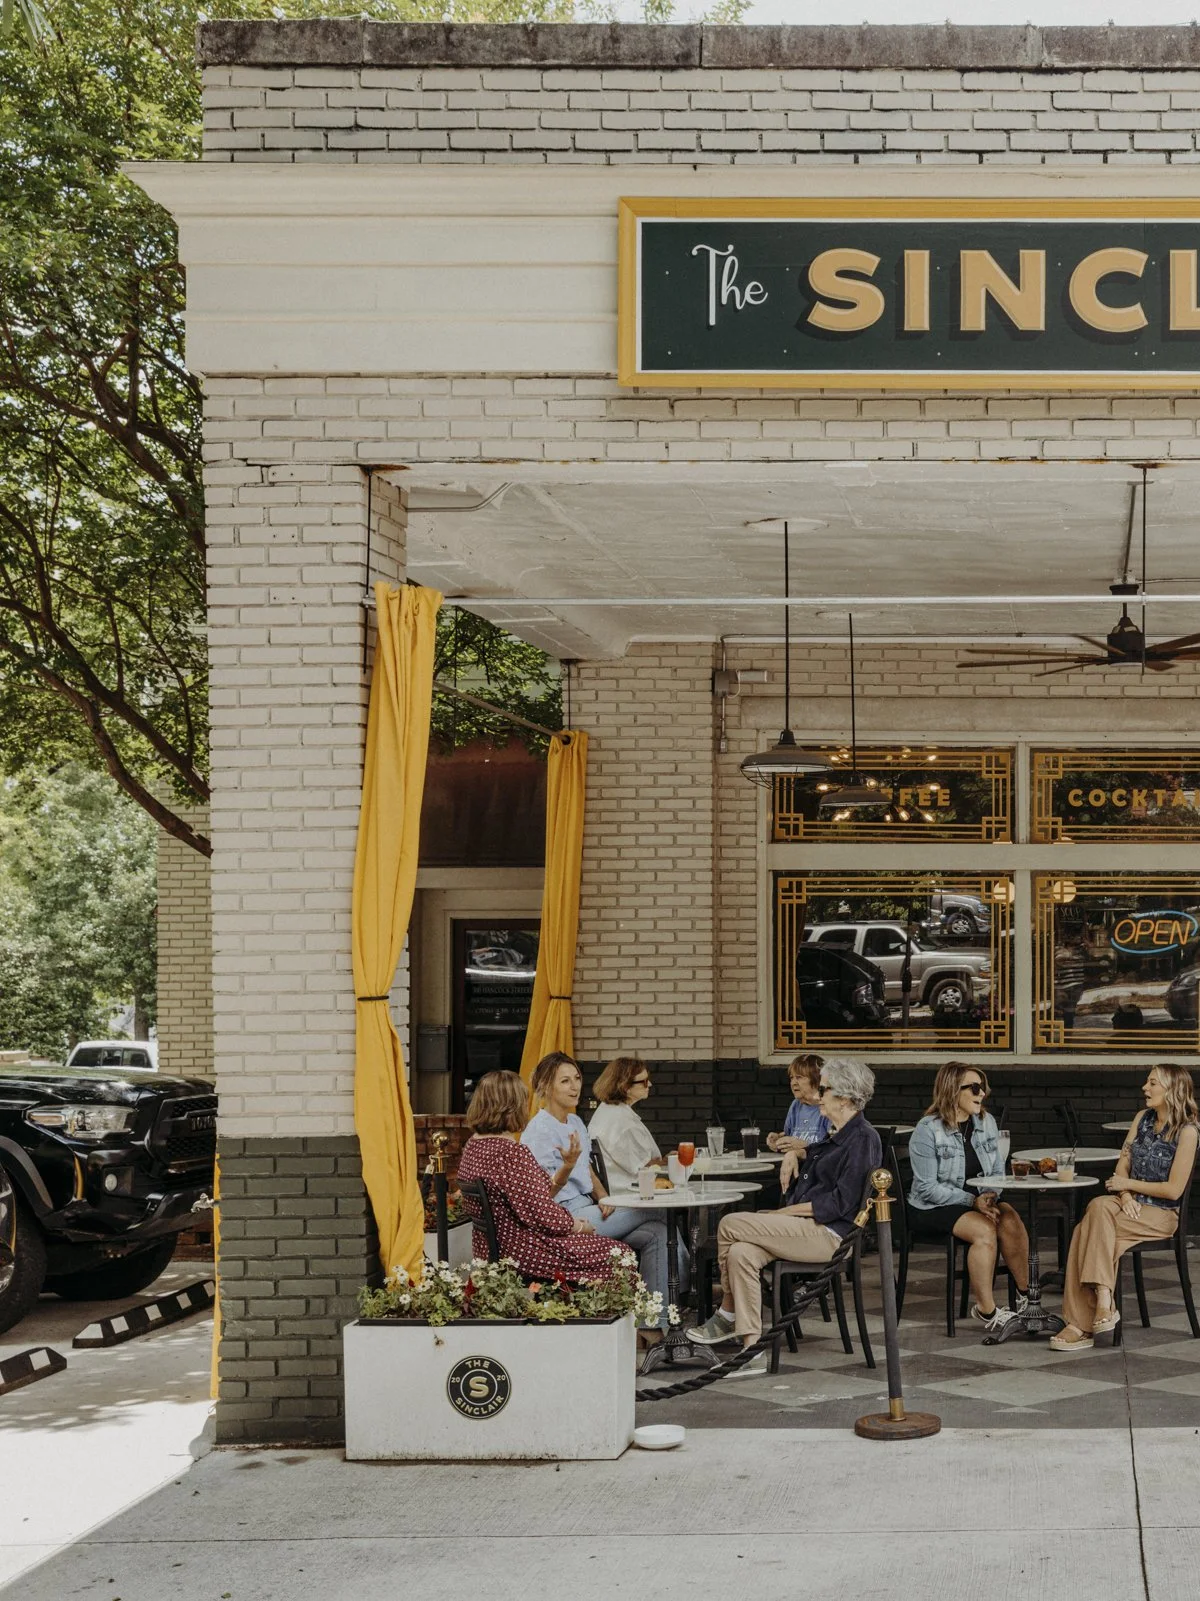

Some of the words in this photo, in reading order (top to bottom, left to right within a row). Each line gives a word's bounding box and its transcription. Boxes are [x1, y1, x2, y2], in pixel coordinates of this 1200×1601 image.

[690, 243, 769, 327] The
[1113, 918, 1191, 946] OPEN
[465, 1360, 490, 1368] THE
[469, 1376, 490, 1398] S
[455, 1395, 504, 1414] SINCLAIR
